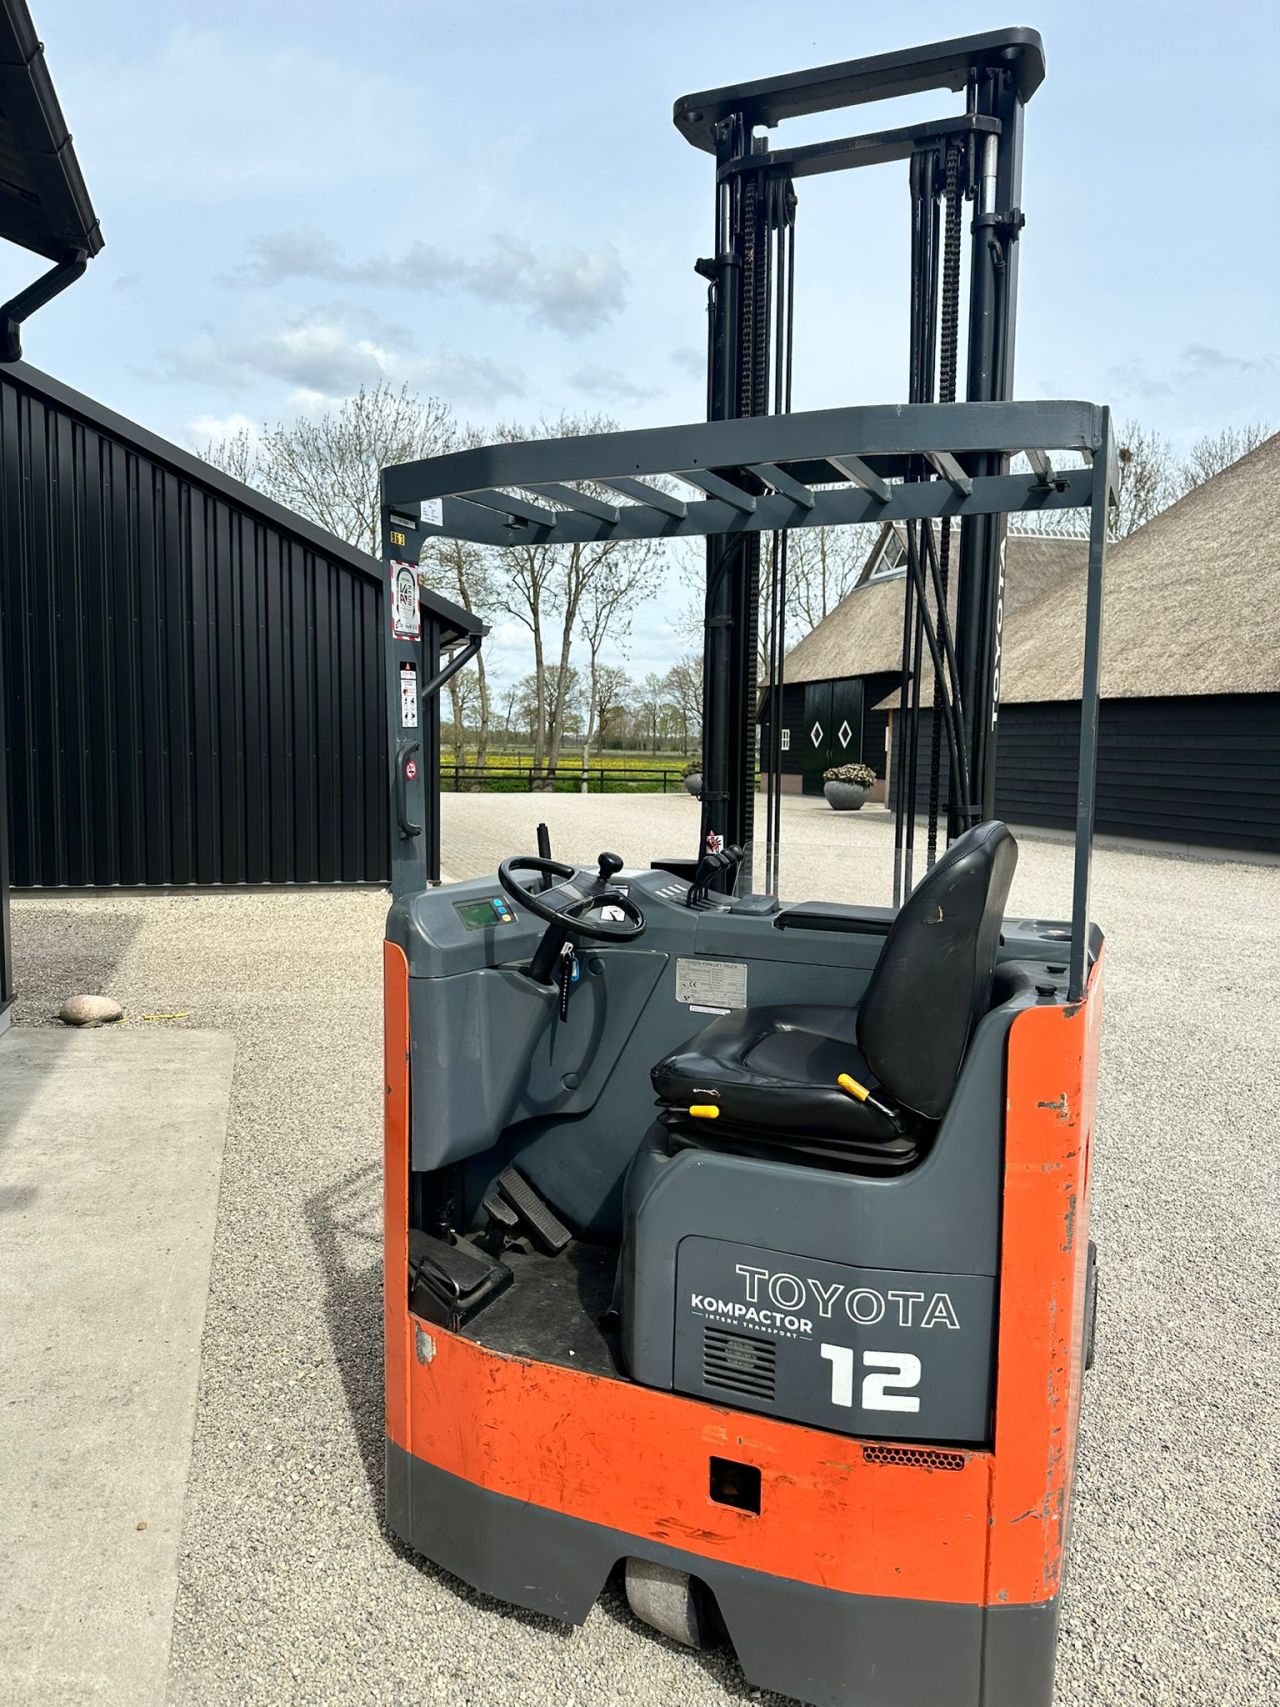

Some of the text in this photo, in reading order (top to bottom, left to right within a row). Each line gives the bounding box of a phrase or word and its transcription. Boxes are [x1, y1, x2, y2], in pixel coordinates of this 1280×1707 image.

[992, 536, 1007, 732] TOYOTA
[691, 1293, 813, 1334] KOMPACTOR
[705, 1313, 797, 1339] INTERN TRANSPORT
[735, 1264, 961, 1330] TOYOTA
[820, 1342, 922, 1413] 12
